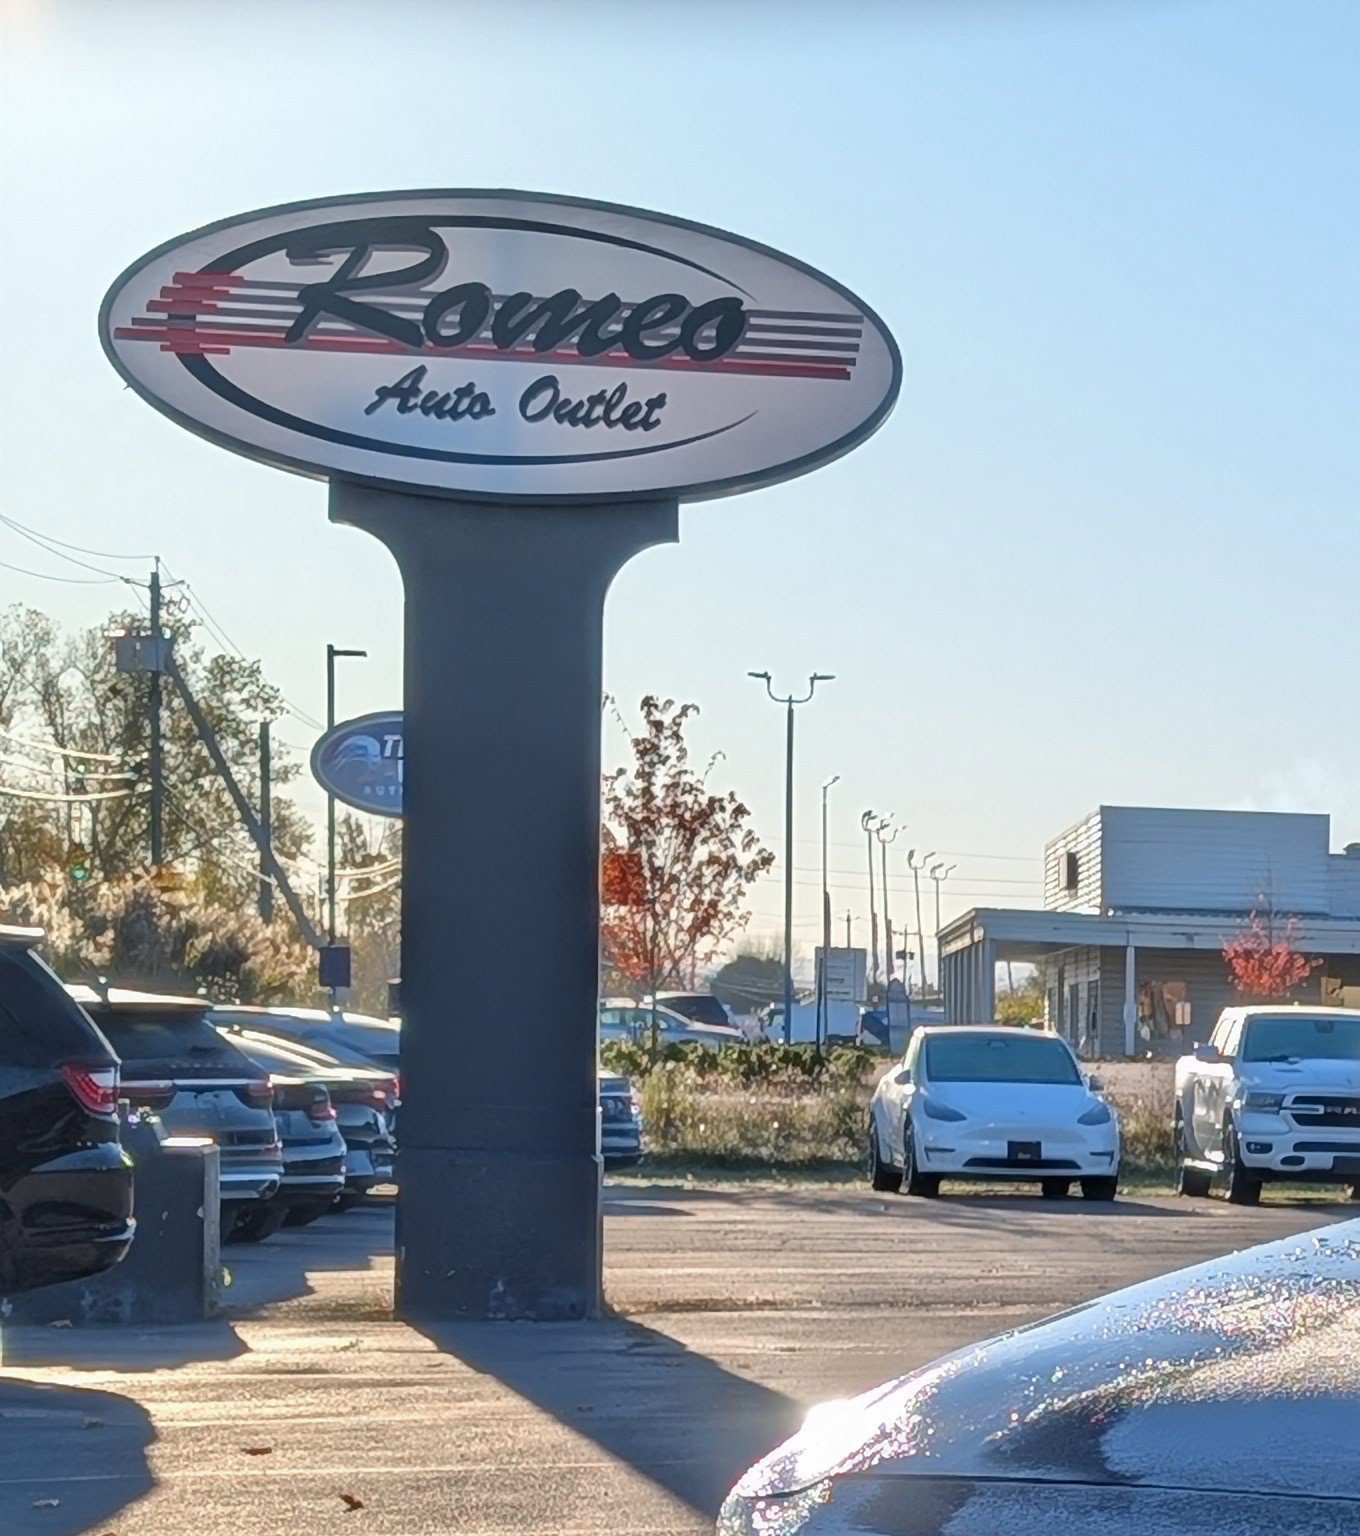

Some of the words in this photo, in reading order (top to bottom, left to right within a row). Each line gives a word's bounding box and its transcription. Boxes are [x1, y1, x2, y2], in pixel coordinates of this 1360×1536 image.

[283, 217, 746, 362] Romeo
[364, 363, 496, 420] Auto
[518, 373, 668, 433] Outlet
[363, 785, 403, 795] AUT
